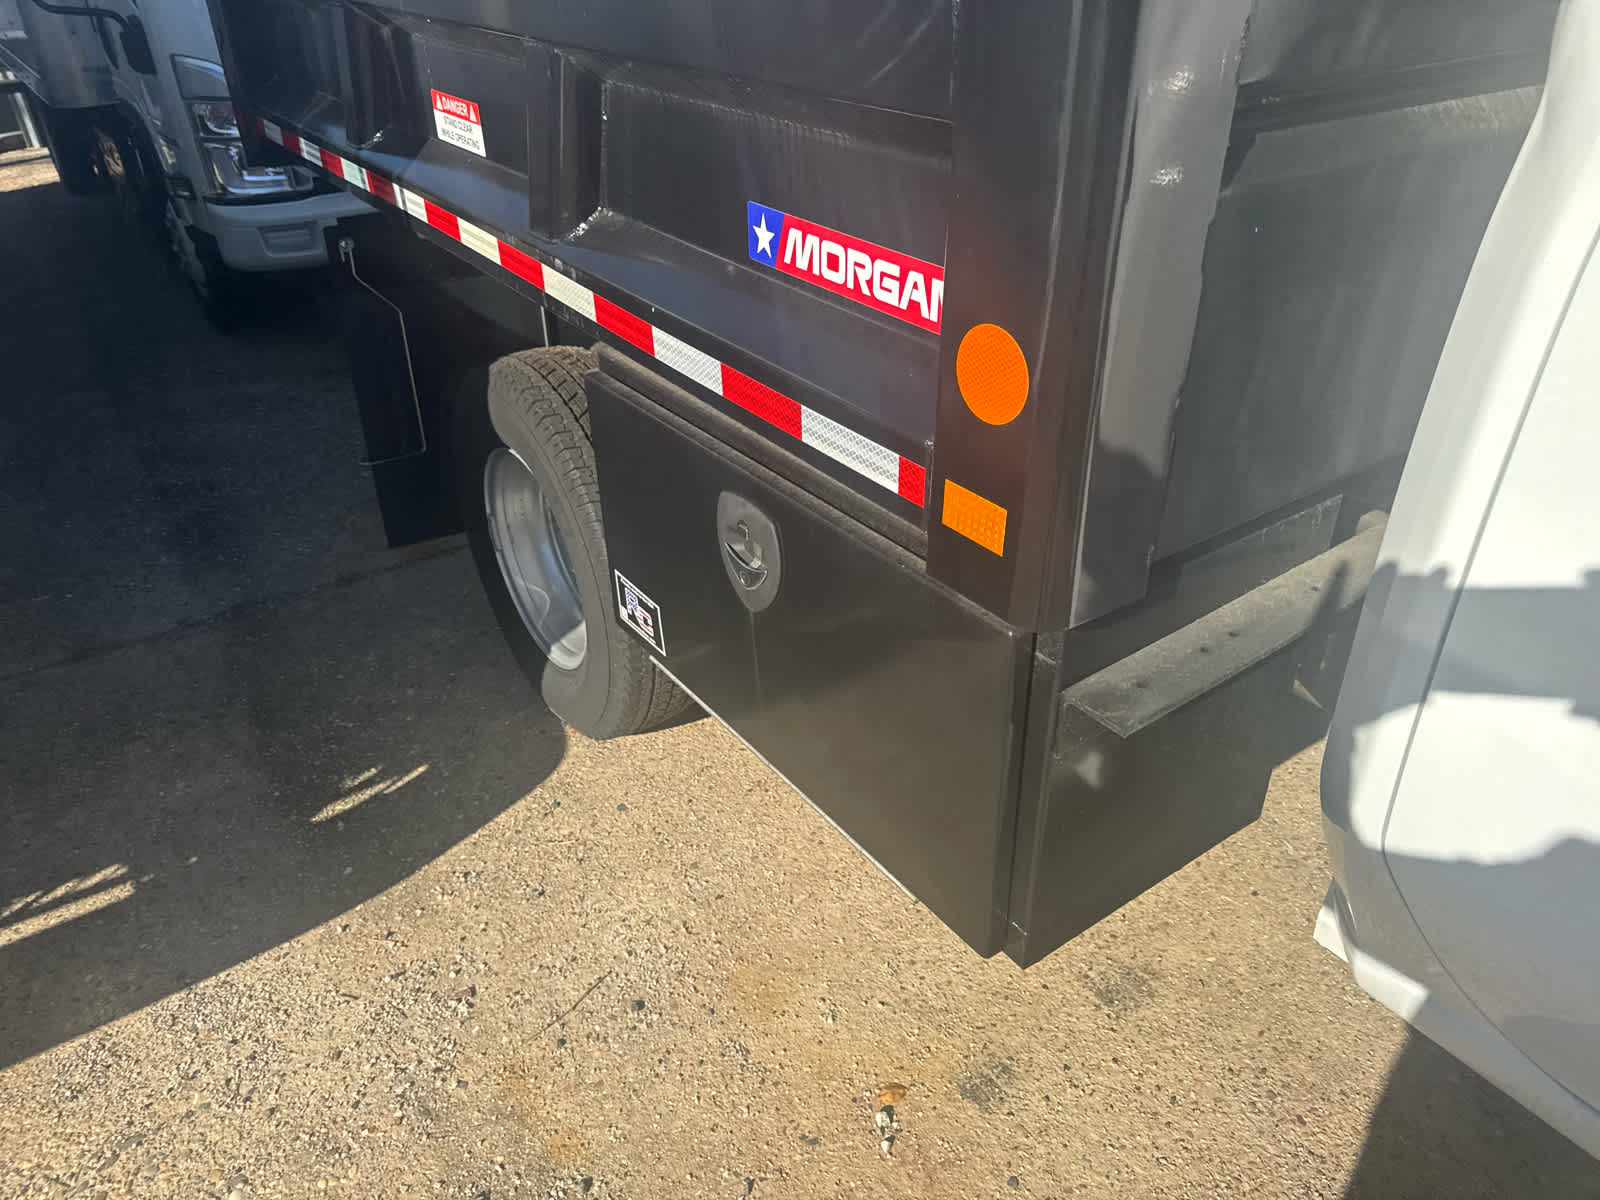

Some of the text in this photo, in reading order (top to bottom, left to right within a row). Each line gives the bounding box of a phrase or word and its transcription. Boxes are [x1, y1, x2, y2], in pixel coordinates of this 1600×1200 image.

[441, 95, 469, 118] DANGER
[458, 120, 473, 133] CLEAR
[455, 133, 480, 150] OPERATING
